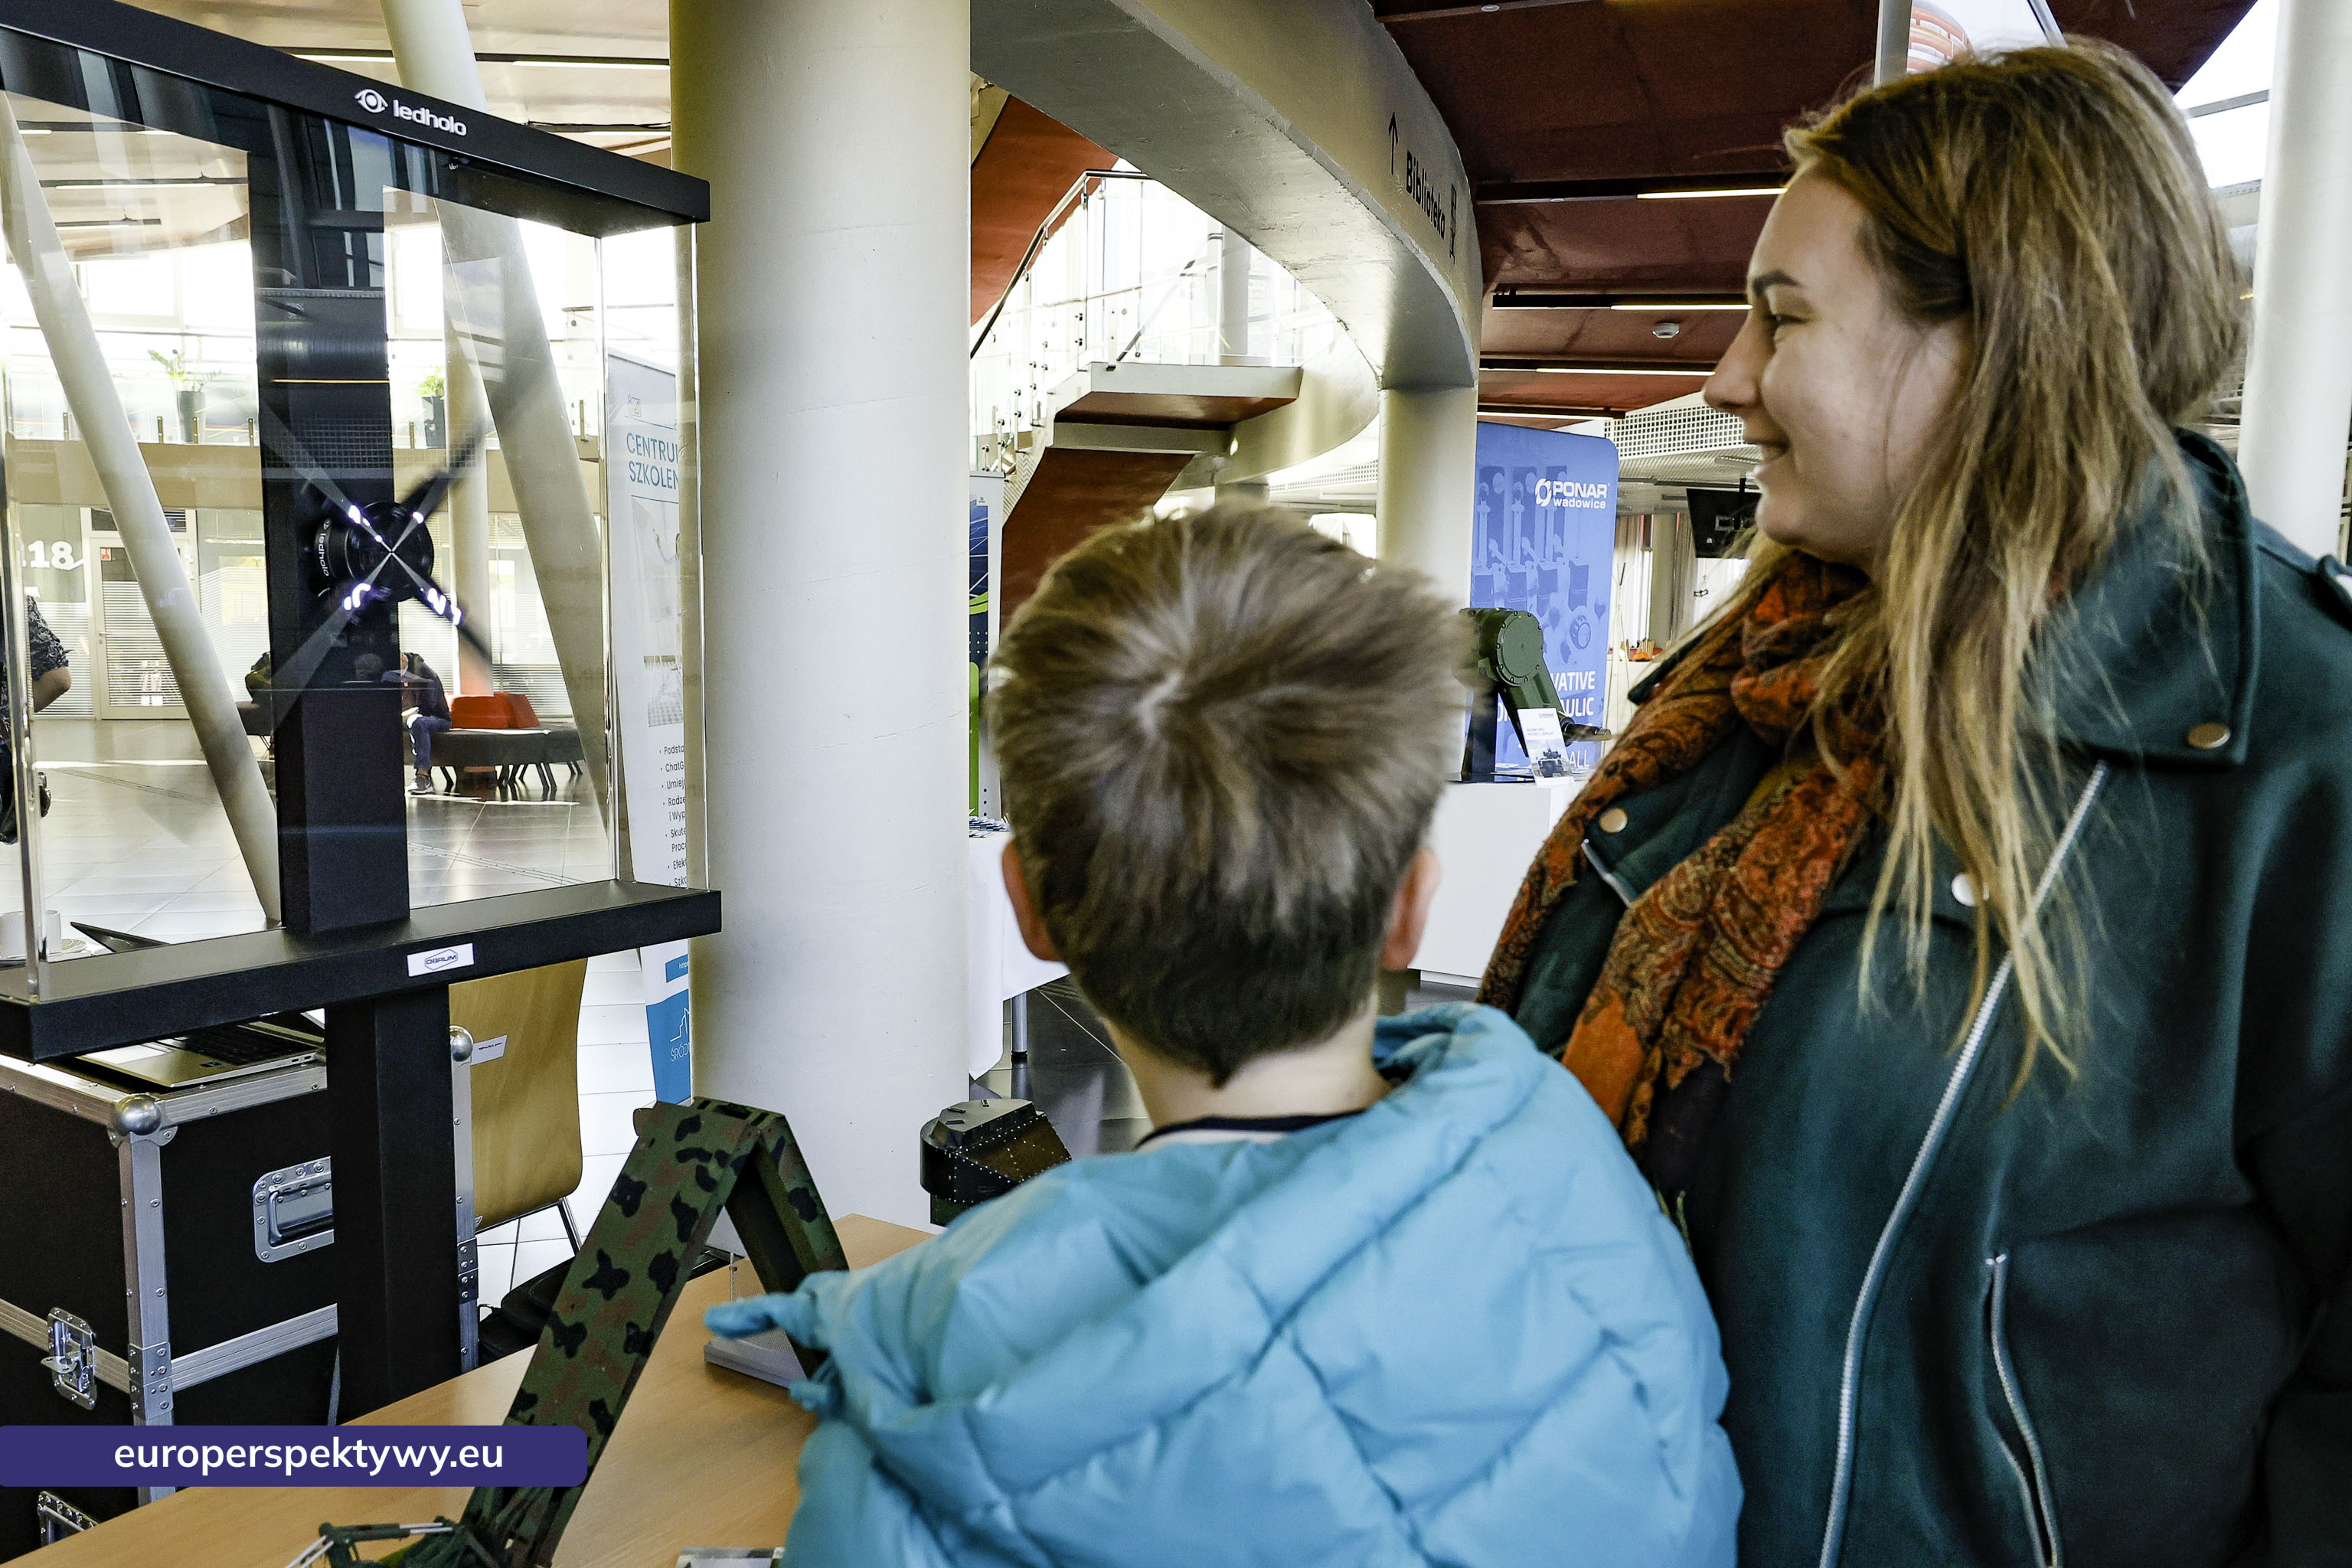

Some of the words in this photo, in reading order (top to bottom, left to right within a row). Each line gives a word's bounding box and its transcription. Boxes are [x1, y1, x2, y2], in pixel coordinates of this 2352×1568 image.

[393, 99, 467, 136] ledholo
[1406, 150, 1446, 240] Biblioteka
[1553, 480, 1608, 499] PONAR
[1553, 498, 1606, 509] wadowice
[318, 533, 329, 577] ledholo
[671, 842, 687, 853] Proc
[426, 955, 458, 965] OBRUM
[671, 1042, 690, 1062] ŚRÓD
